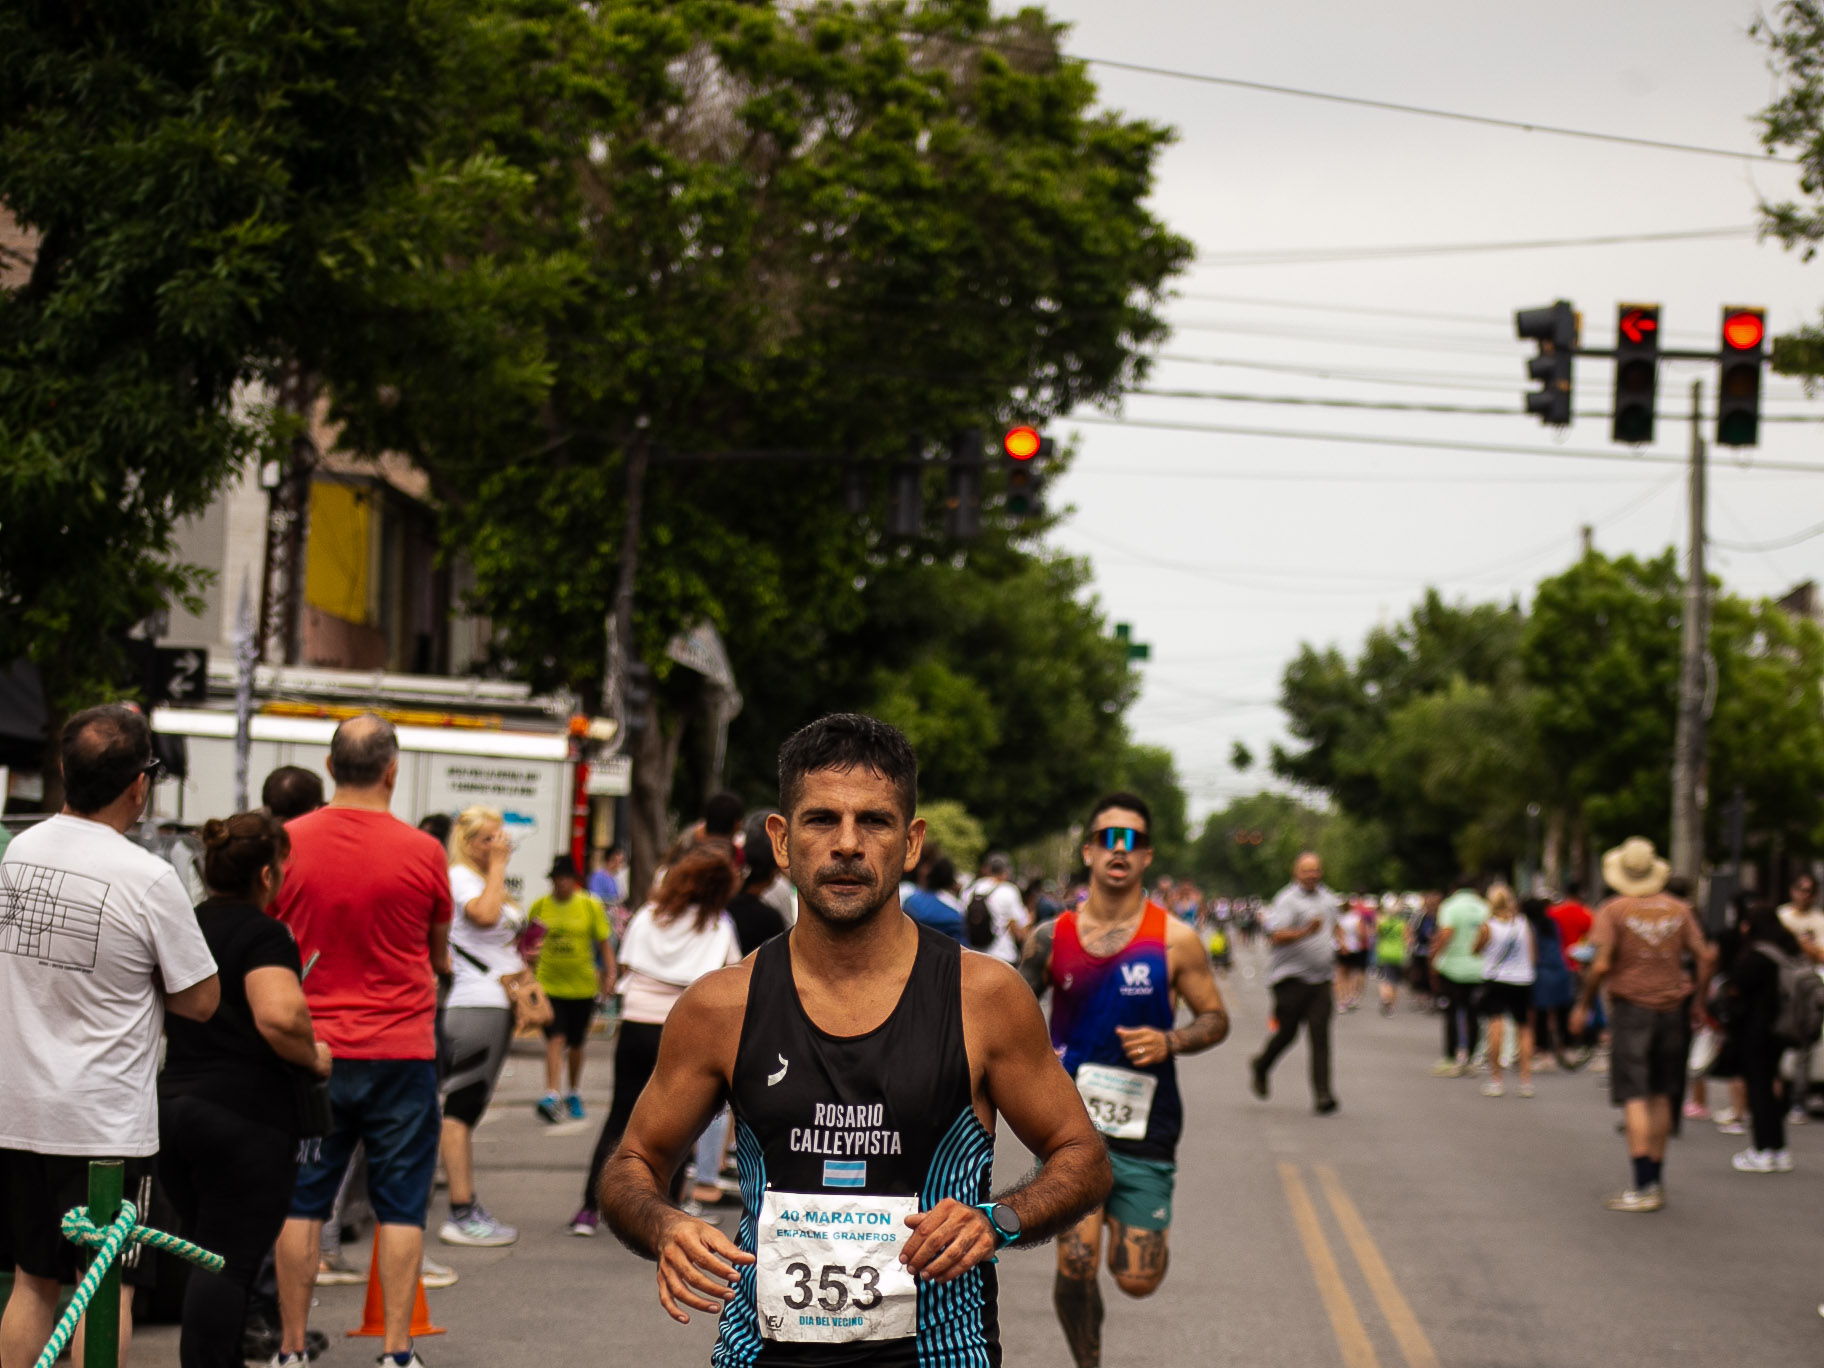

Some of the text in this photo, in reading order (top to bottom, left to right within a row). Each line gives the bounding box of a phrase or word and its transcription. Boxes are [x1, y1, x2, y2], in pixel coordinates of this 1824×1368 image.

[1120, 962, 1152, 986] VR
[814, 1102, 884, 1128] ROSARIO
[790, 1127, 902, 1155] CALLEYPISTA
[780, 1209, 892, 1226] 40 MARATON
[776, 1228, 897, 1242] EMPALME GRANEROS
[783, 1262, 884, 1311] 353
[799, 1315, 864, 1327] DIA DEL VECINO
